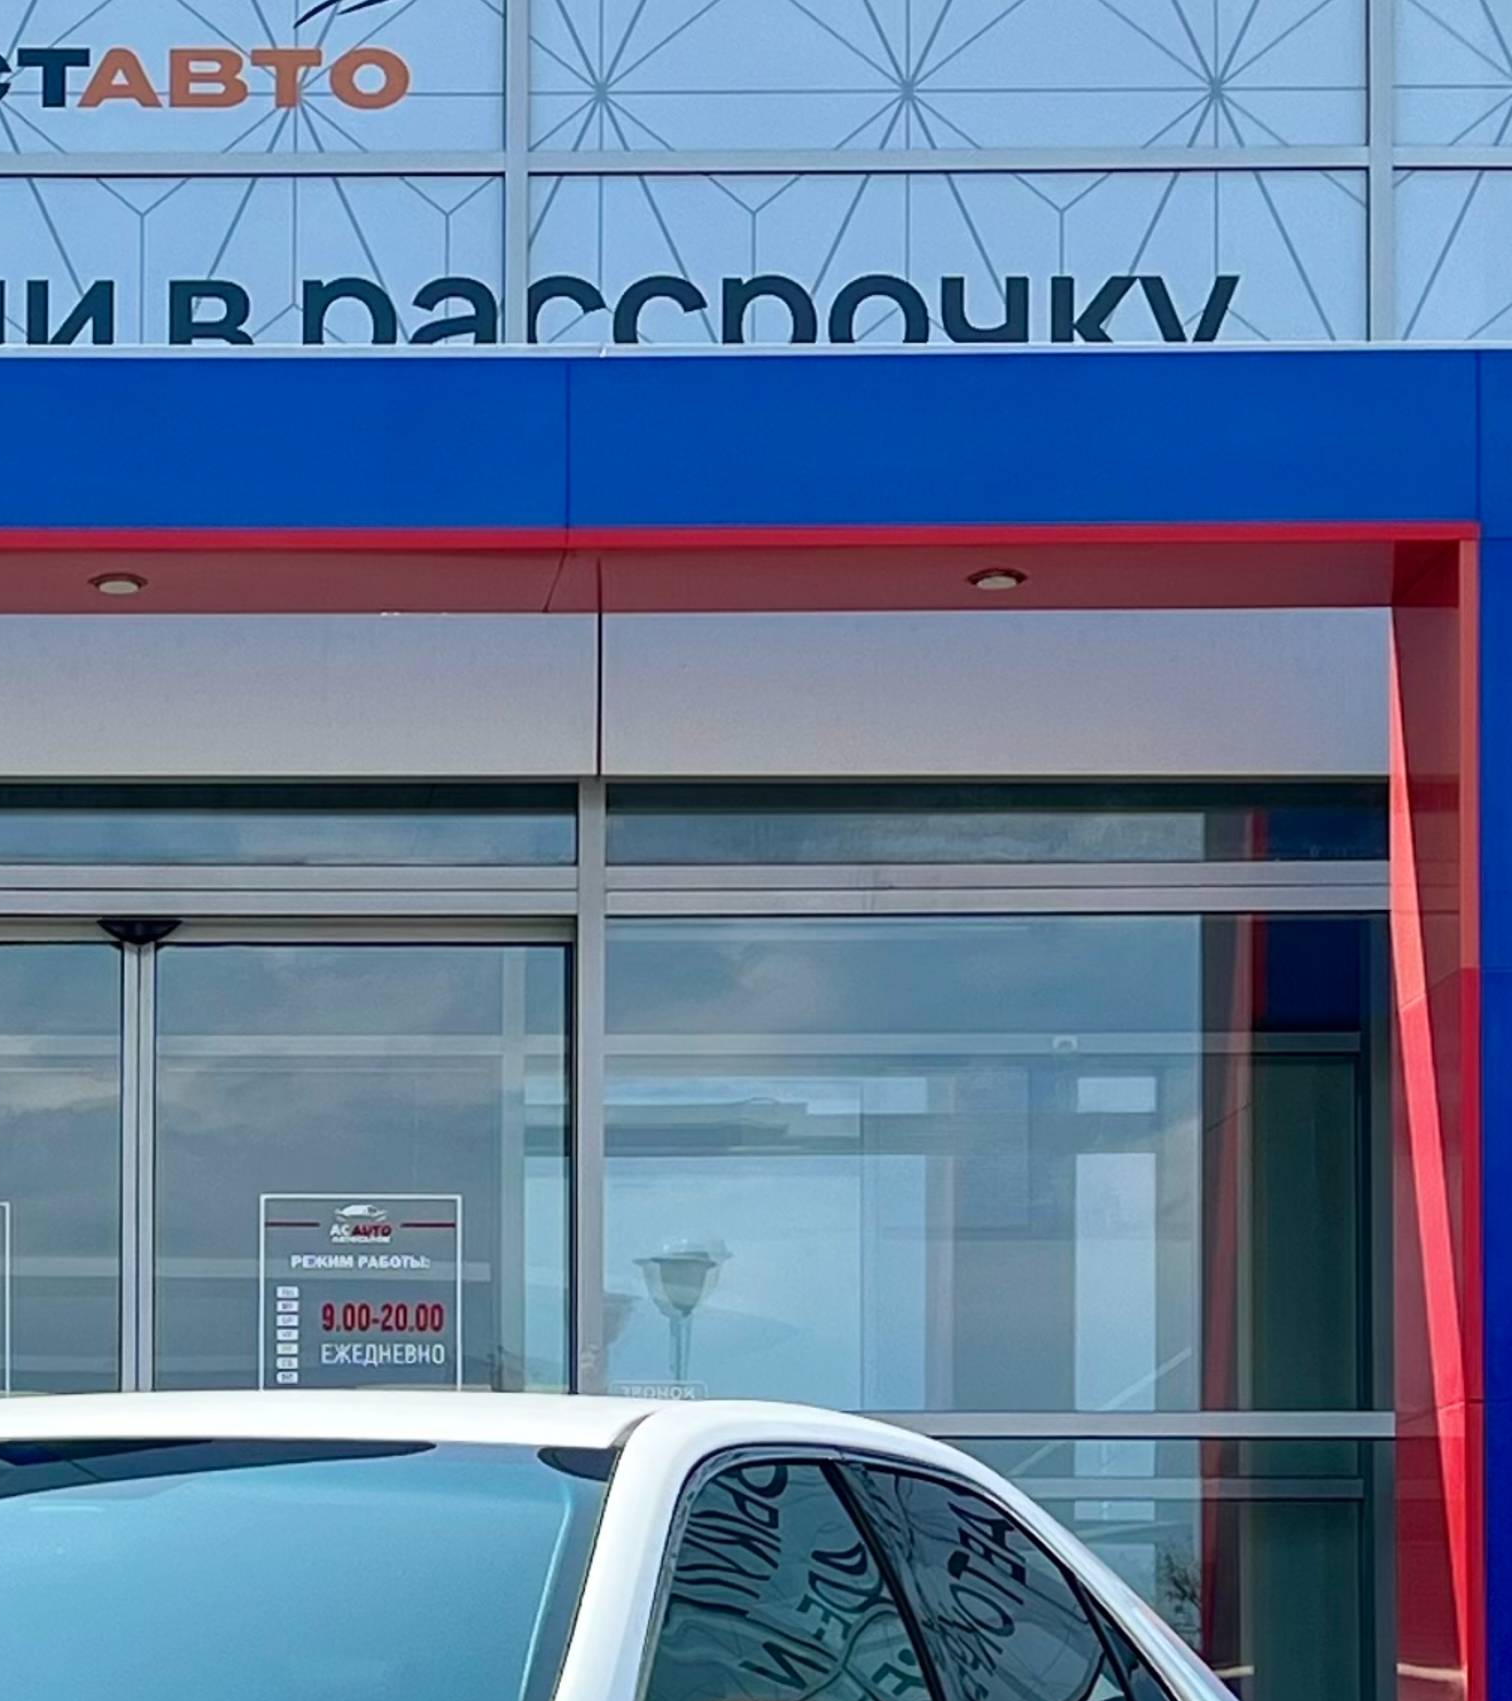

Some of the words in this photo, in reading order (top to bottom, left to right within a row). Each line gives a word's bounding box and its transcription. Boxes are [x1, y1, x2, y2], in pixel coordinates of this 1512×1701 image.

[291, 1255, 354, 1269] РЕЖИМ
[321, 1303, 444, 1332] 9.00-20.00
[321, 1343, 445, 1367] ЕЖЕДНЕВНО
